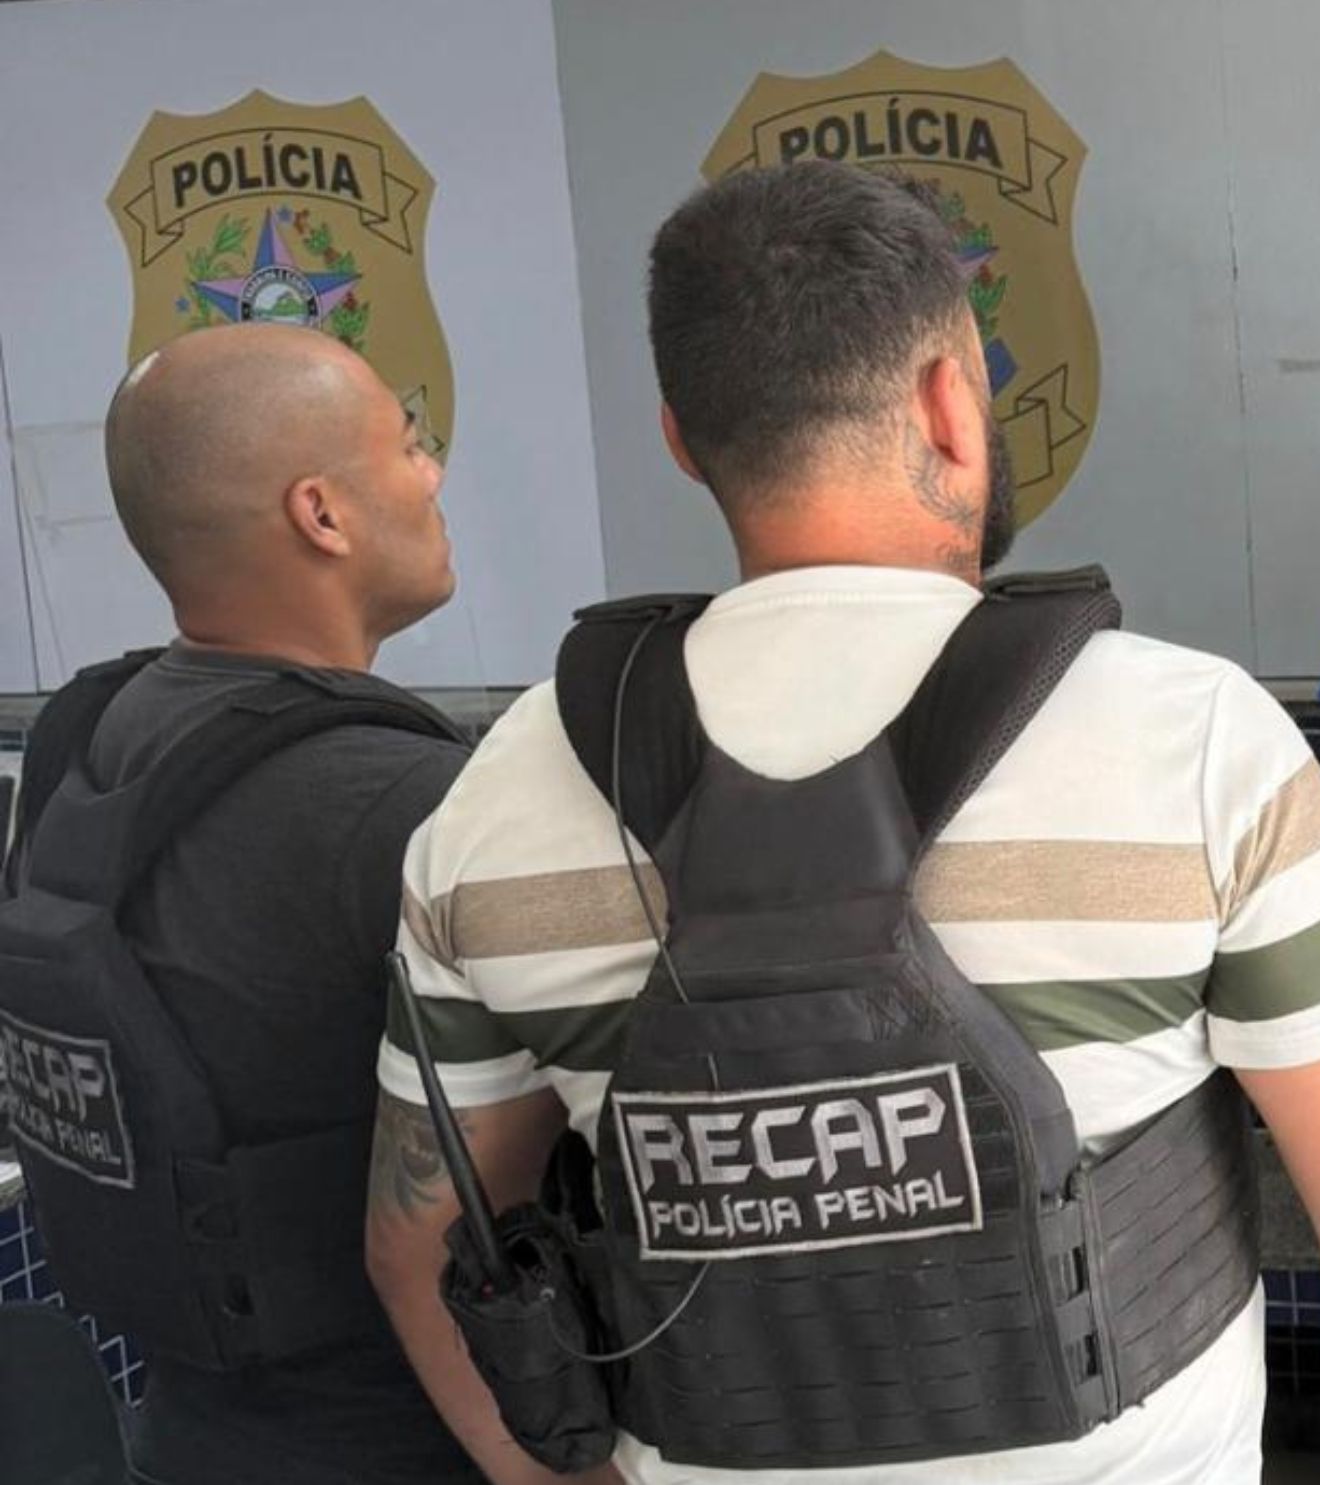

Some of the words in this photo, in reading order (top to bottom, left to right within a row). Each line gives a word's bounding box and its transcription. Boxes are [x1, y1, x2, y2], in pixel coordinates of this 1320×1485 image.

[172, 133, 362, 208] POLÍCIA
[780, 98, 1003, 170] POLÍCIA
[0, 1023, 105, 1122] ECAP
[626, 1086, 946, 1195] RECAP
[648, 1194, 802, 1240] POLÍCIA
[813, 1169, 965, 1230] PENAL
